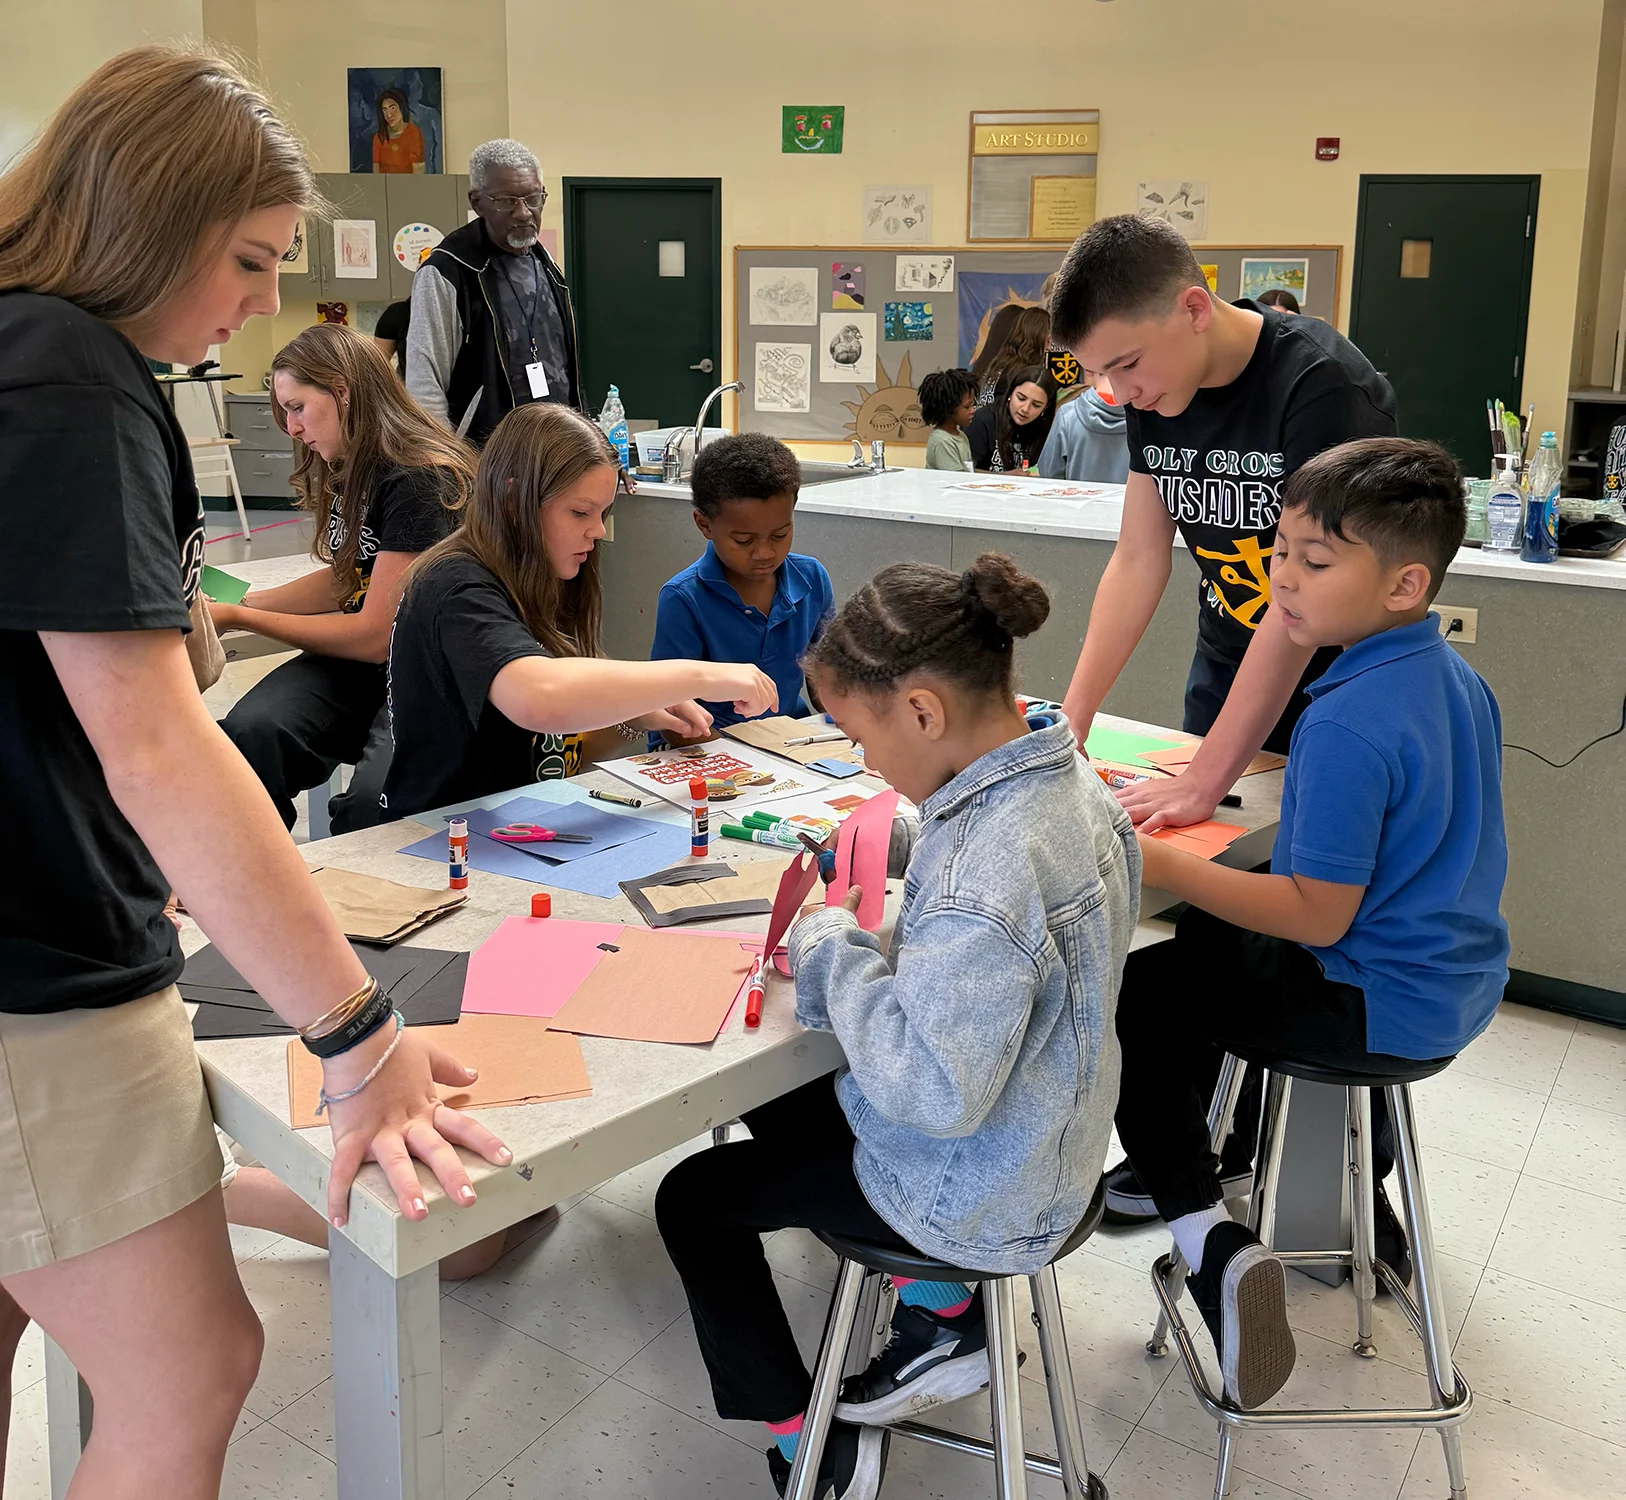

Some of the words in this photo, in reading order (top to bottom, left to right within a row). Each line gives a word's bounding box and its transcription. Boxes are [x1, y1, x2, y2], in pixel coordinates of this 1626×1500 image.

[985, 133, 1021, 148] ART
[1024, 131, 1088, 148] STUDIO
[654, 759, 737, 778] scarecrow
[701, 761, 748, 776] paper
